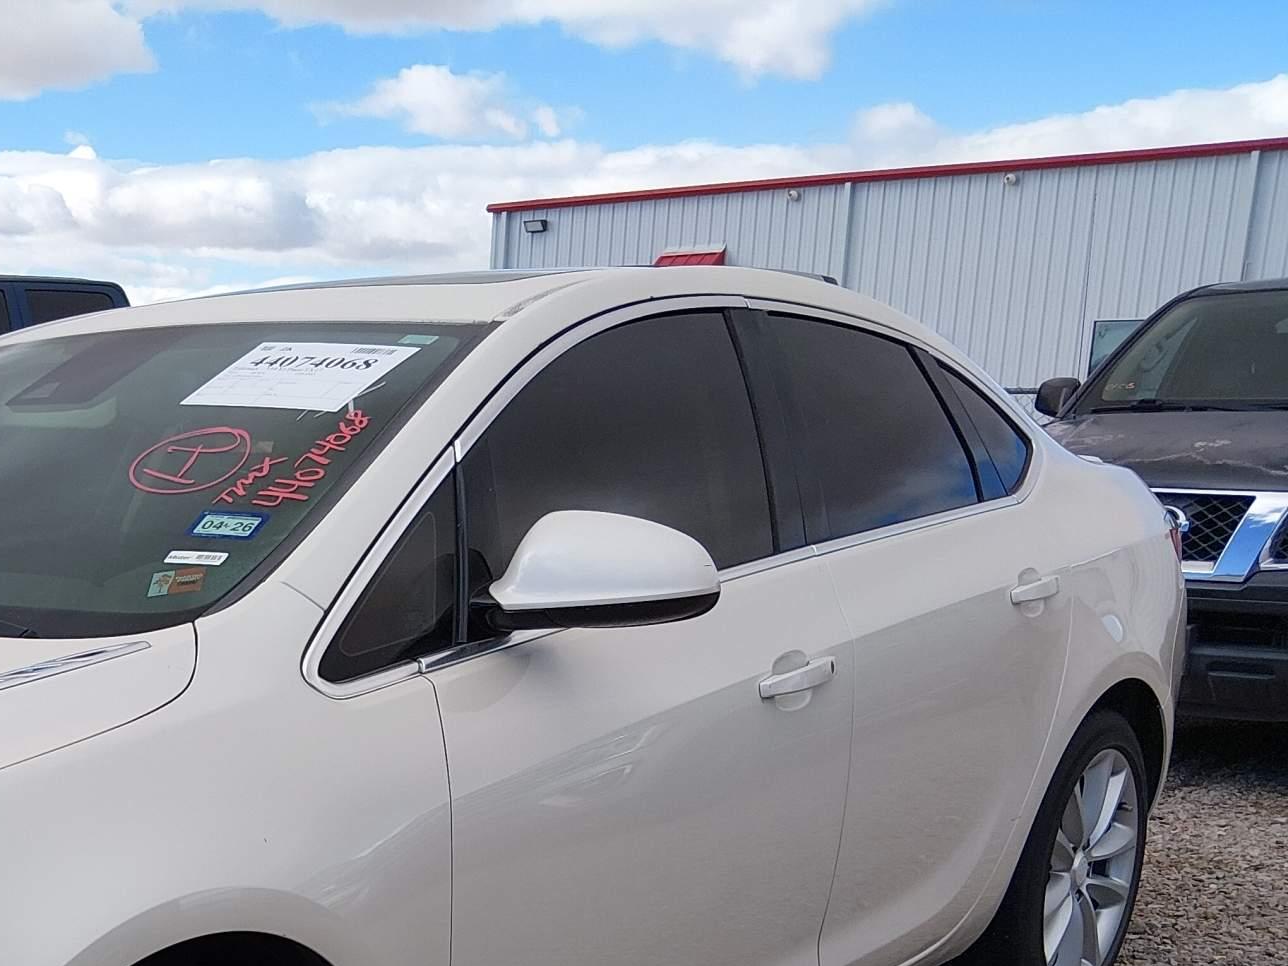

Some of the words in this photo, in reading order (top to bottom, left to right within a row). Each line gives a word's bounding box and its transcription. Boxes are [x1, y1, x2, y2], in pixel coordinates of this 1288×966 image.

[250, 355, 378, 370] 44074068
[252, 410, 371, 507] 44074068
[201, 520, 224, 530] 04
[230, 522, 255, 532] 26
